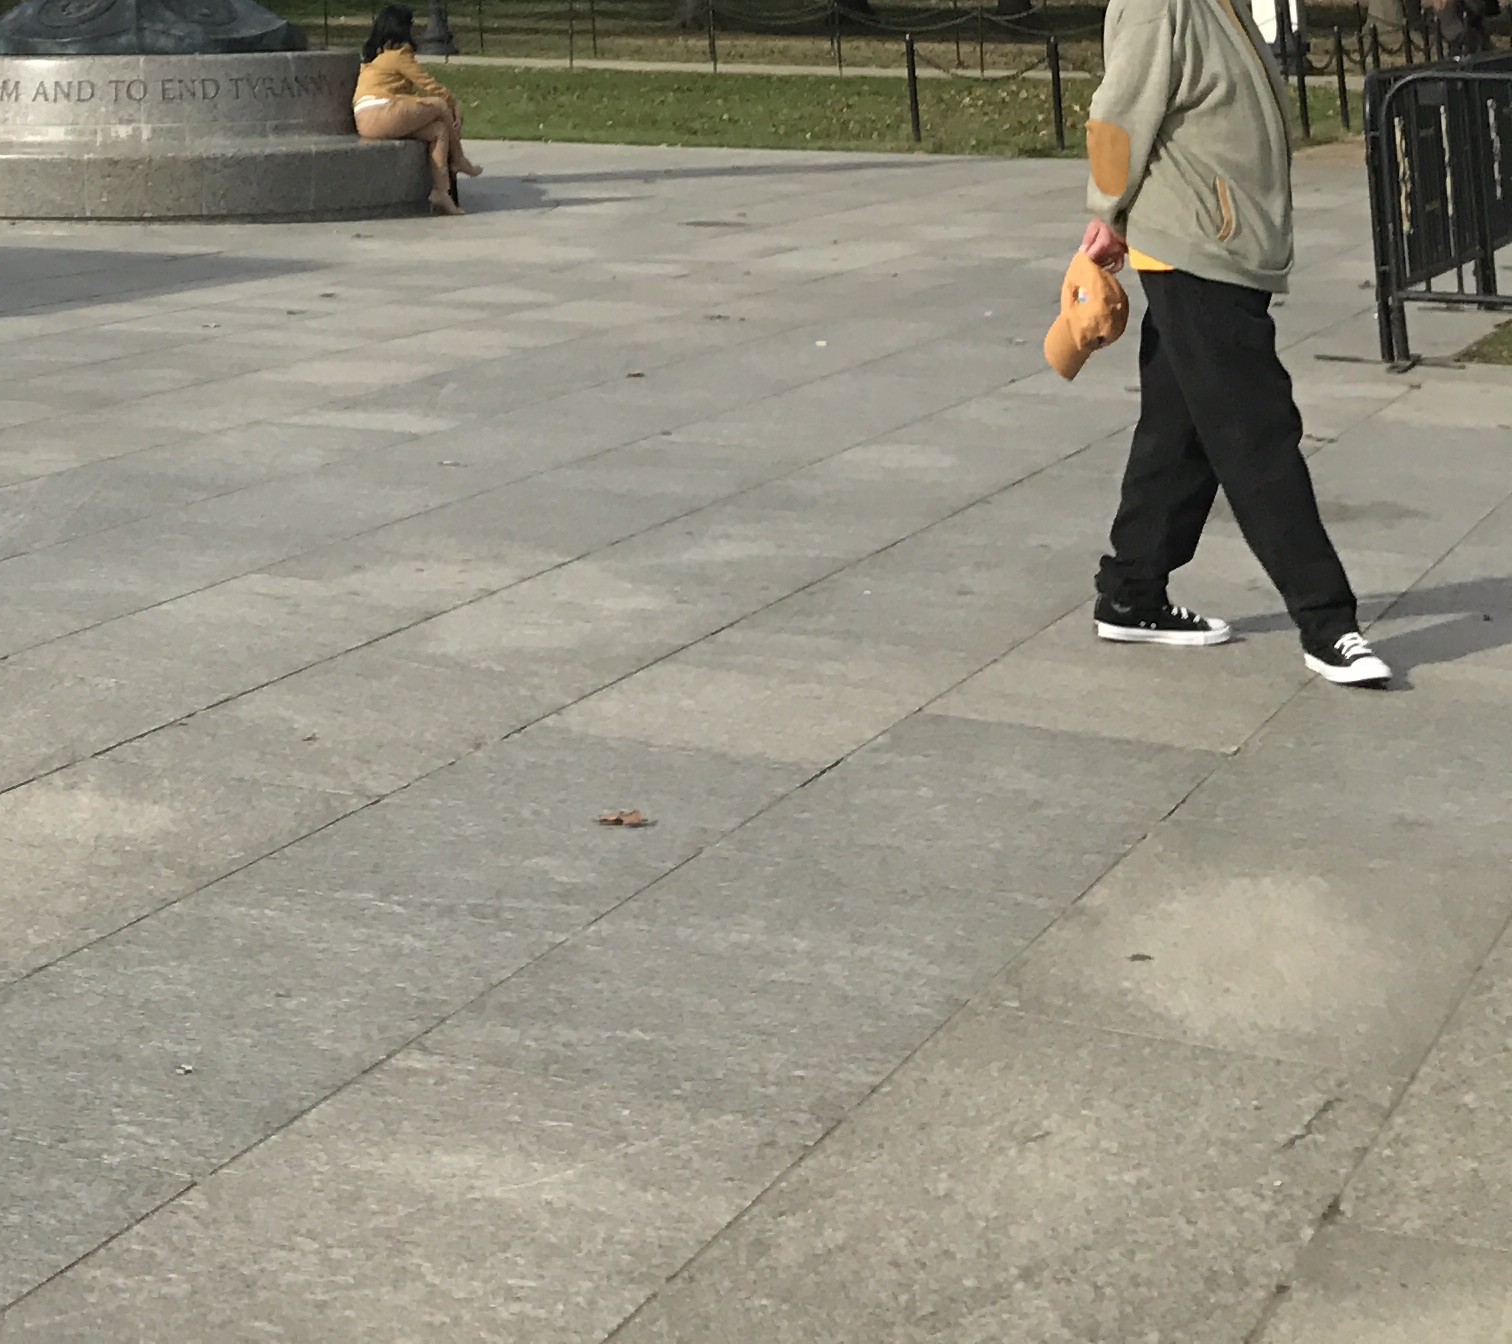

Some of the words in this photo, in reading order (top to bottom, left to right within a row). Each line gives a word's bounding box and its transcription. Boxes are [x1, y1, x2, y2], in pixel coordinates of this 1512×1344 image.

[32, 80, 96, 102] AND
[108, 78, 148, 102] TO
[160, 78, 221, 102] END
